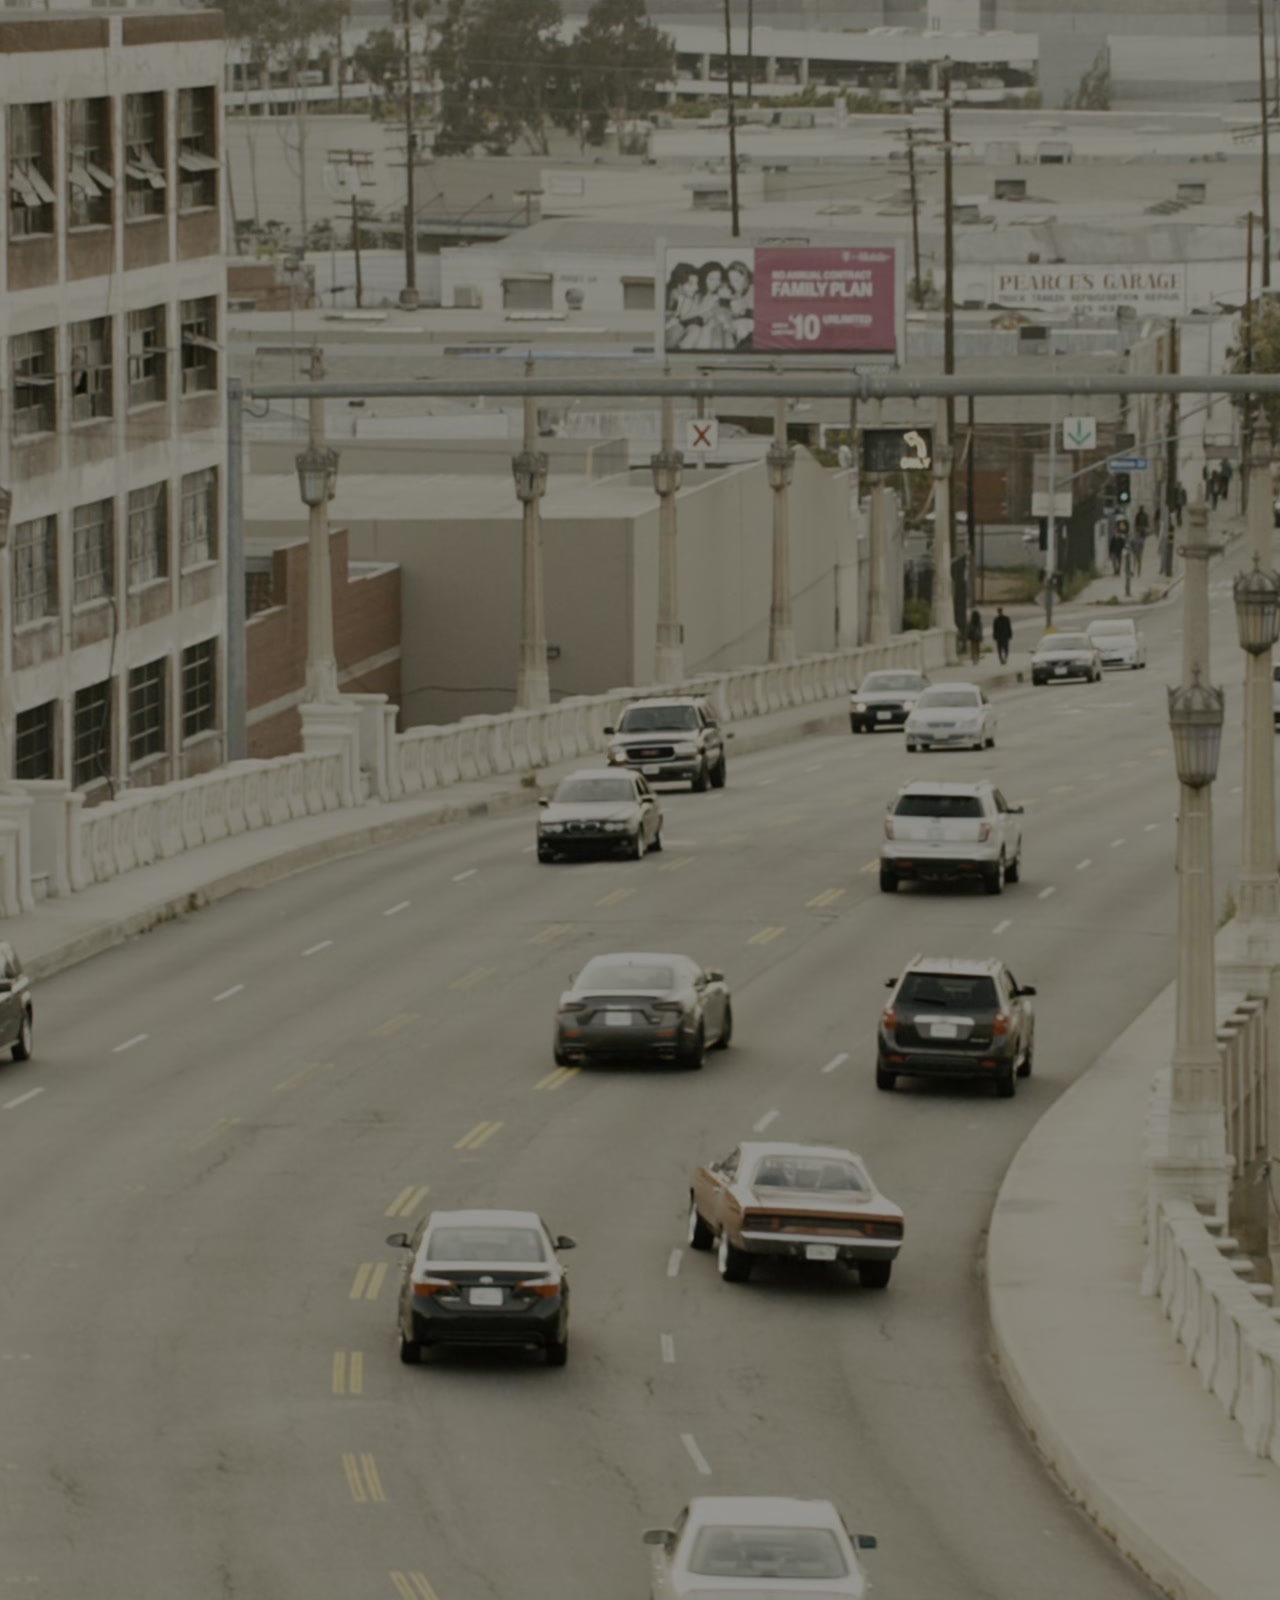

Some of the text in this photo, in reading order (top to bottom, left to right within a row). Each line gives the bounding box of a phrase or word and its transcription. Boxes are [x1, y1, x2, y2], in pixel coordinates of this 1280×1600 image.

[771, 281, 873, 297] FAMILY PLAN
[1103, 273, 1182, 289] GARAGE
